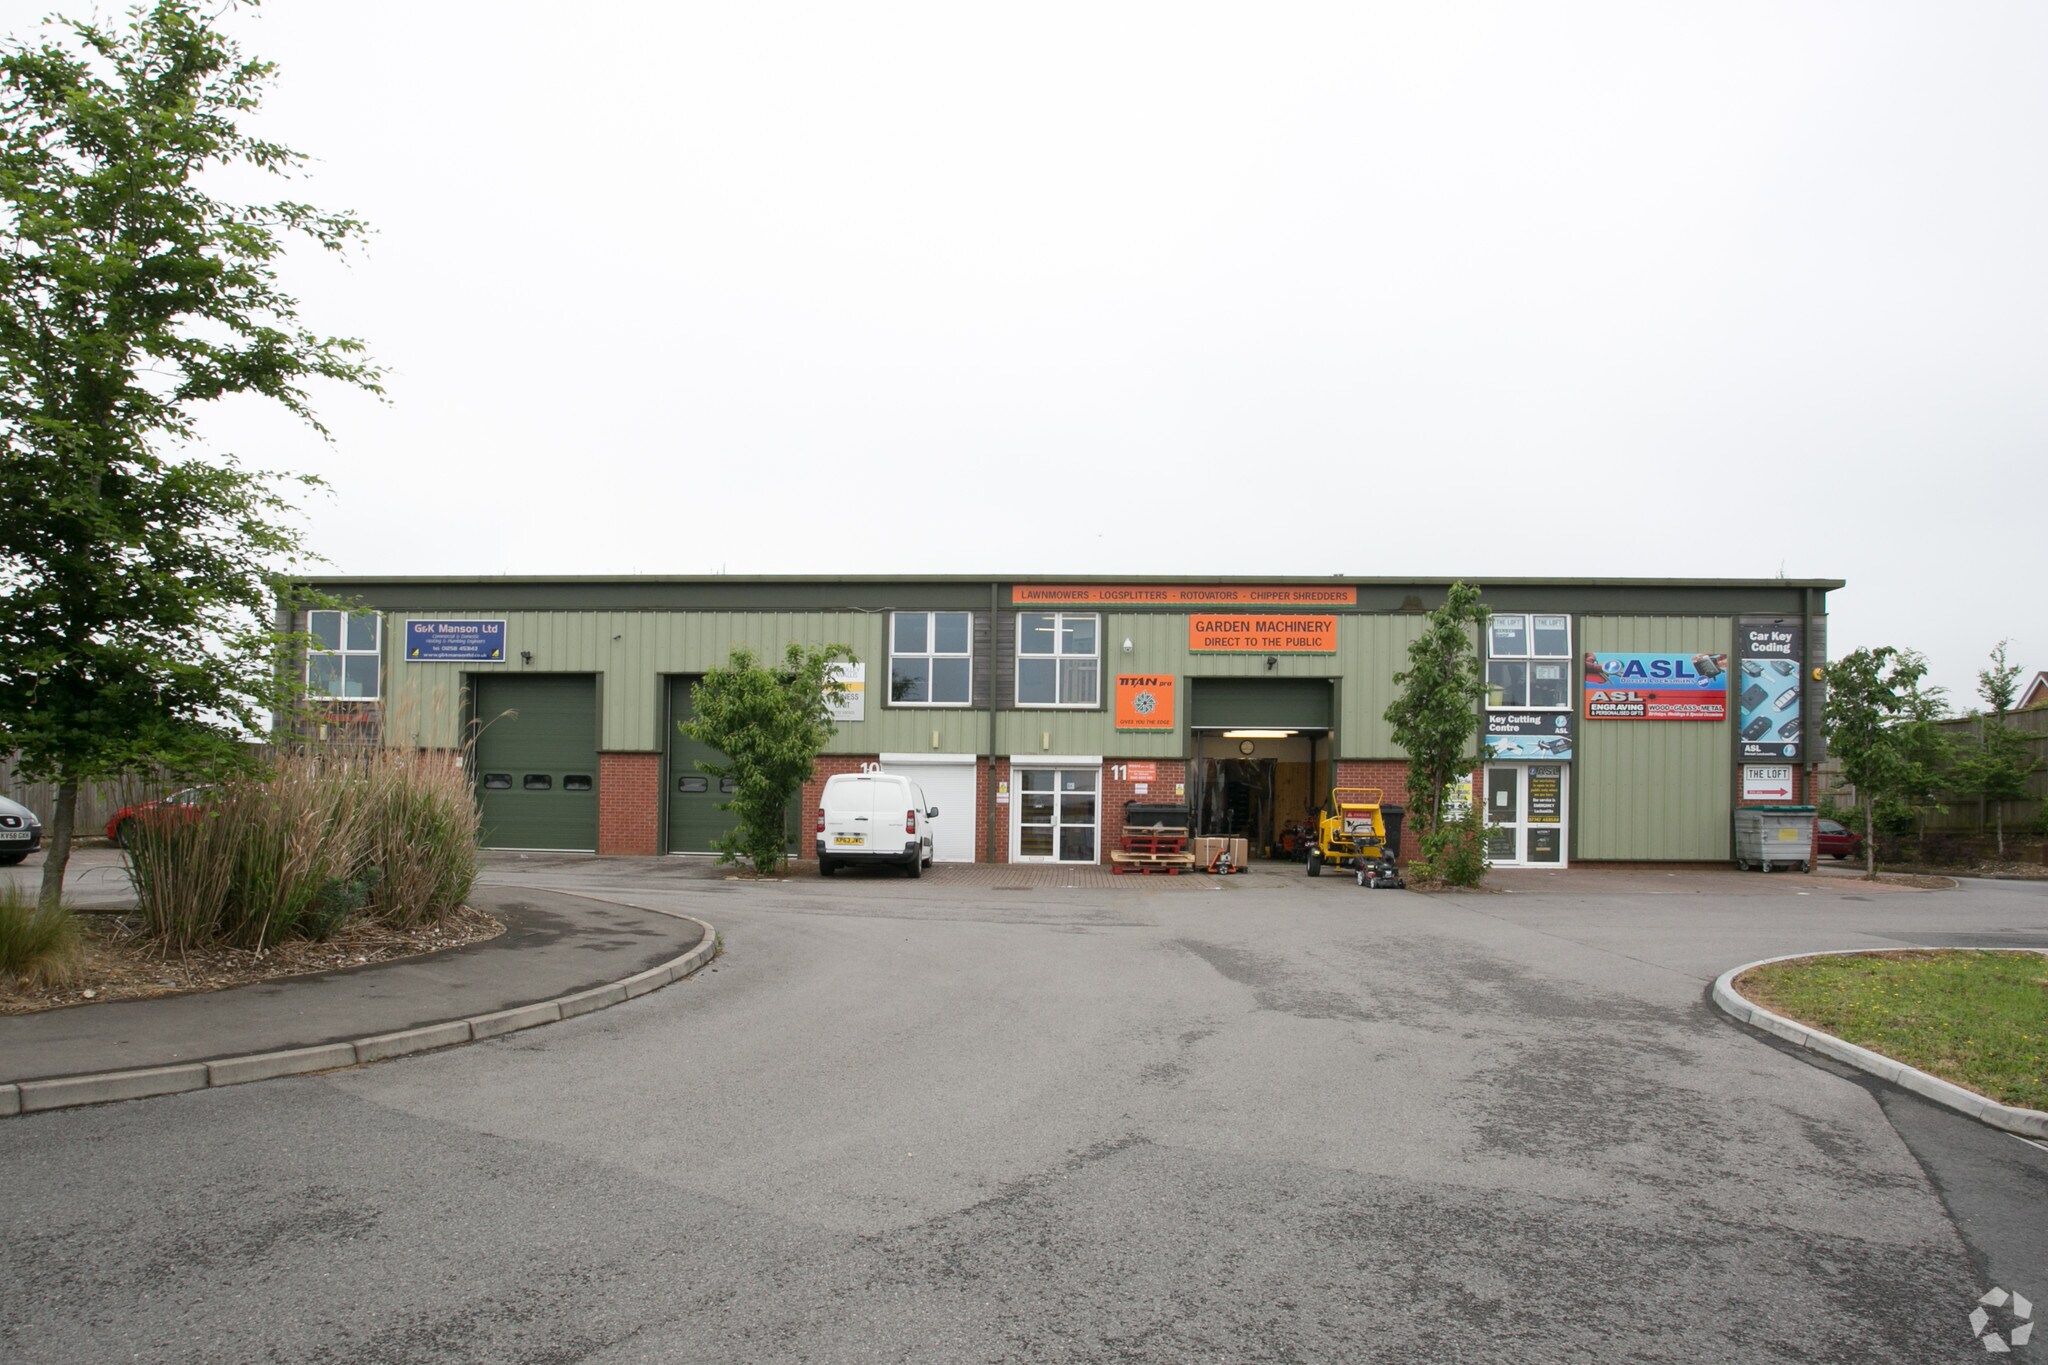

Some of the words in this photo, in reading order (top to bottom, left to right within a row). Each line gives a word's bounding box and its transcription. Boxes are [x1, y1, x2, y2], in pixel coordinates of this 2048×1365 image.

[1021, 591, 1089, 600] LAWNMOWERS
[1099, 591, 1168, 600] LOGSPLITTERS
[1180, 591, 1238, 600] ROTOVATORS
[1250, 591, 1290, 600] CHIPPER
[1292, 591, 1348, 601] SHREDDERS
[414, 624, 435, 633] G&K
[438, 624, 478, 633] Manson
[482, 624, 498, 633] Ltd
[1195, 621, 1250, 633] GARDEN
[1255, 621, 1332, 633] MACHINERY
[1204, 637, 1240, 647] DIRECT
[1244, 637, 1257, 647] TO
[1262, 637, 1281, 647] THE
[1286, 637, 1322, 647] PUBLIC
[1749, 631, 1769, 641] Car
[1771, 631, 1792, 643] Key
[1751, 642, 1791, 654] Coding
[1622, 659, 1695, 678] ASL
[1119, 678, 1157, 688] TITAN
[1590, 691, 1645, 702] ASL
[1700, 704, 1724, 712] METAL
[1489, 715, 1506, 725] Key
[1507, 715, 1541, 726] Cutting
[1489, 724, 1520, 732] Centre
[1744, 744, 1762, 752] ASL
[860, 762, 880, 774] 10
[1111, 764, 1127, 781] 11
[1537, 767, 1559, 775] ASL
[1749, 769, 1764, 779] THE
[1767, 769, 1788, 779] LOFT
